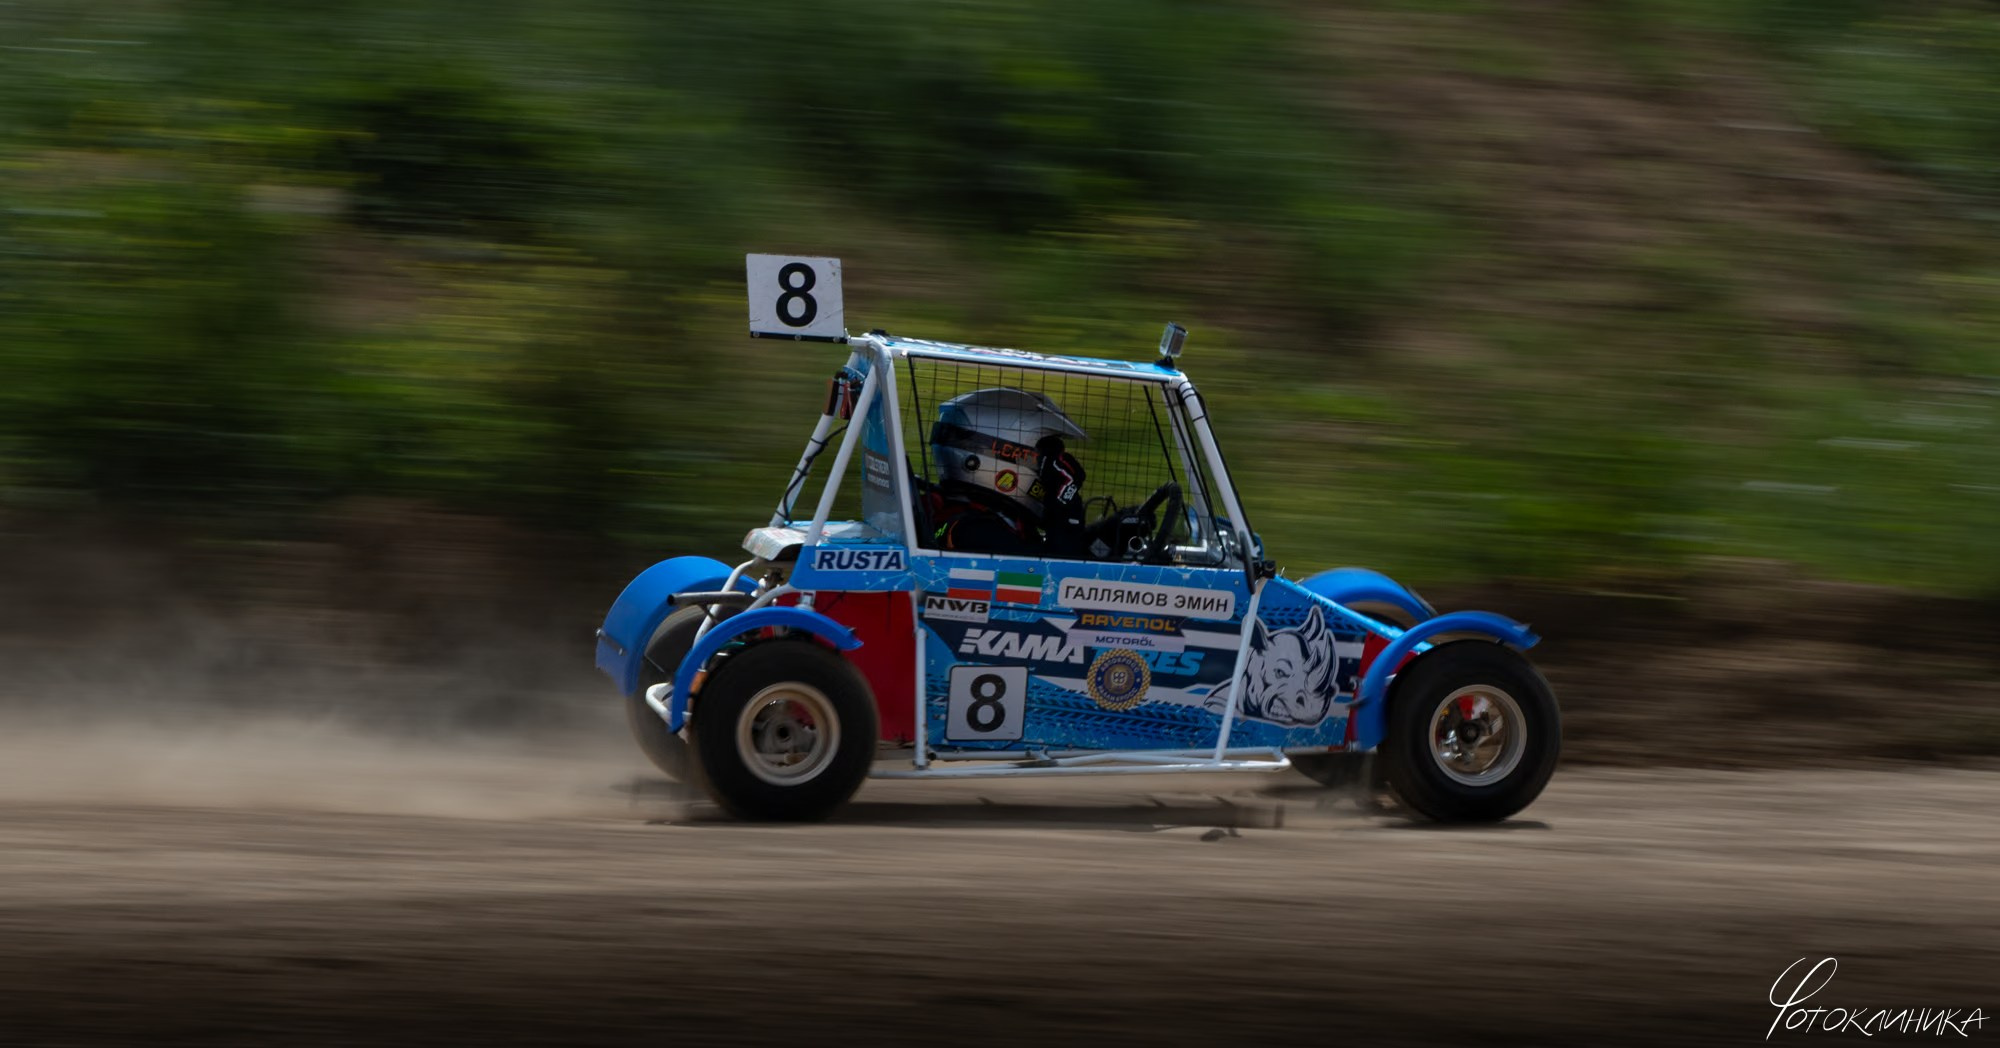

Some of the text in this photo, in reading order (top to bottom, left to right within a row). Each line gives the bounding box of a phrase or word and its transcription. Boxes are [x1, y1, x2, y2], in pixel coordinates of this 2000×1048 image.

[775, 262, 818, 328] 8
[816, 549, 903, 571] RUSTA
[927, 598, 989, 614] NWB
[1064, 585, 1229, 612] ГАЛЛЯМОВ ЭМИН
[1081, 613, 1176, 632] RAVENOL
[959, 628, 1085, 664] KAMA
[1095, 636, 1156, 647] MOTORÖL
[966, 673, 1006, 733] 8
